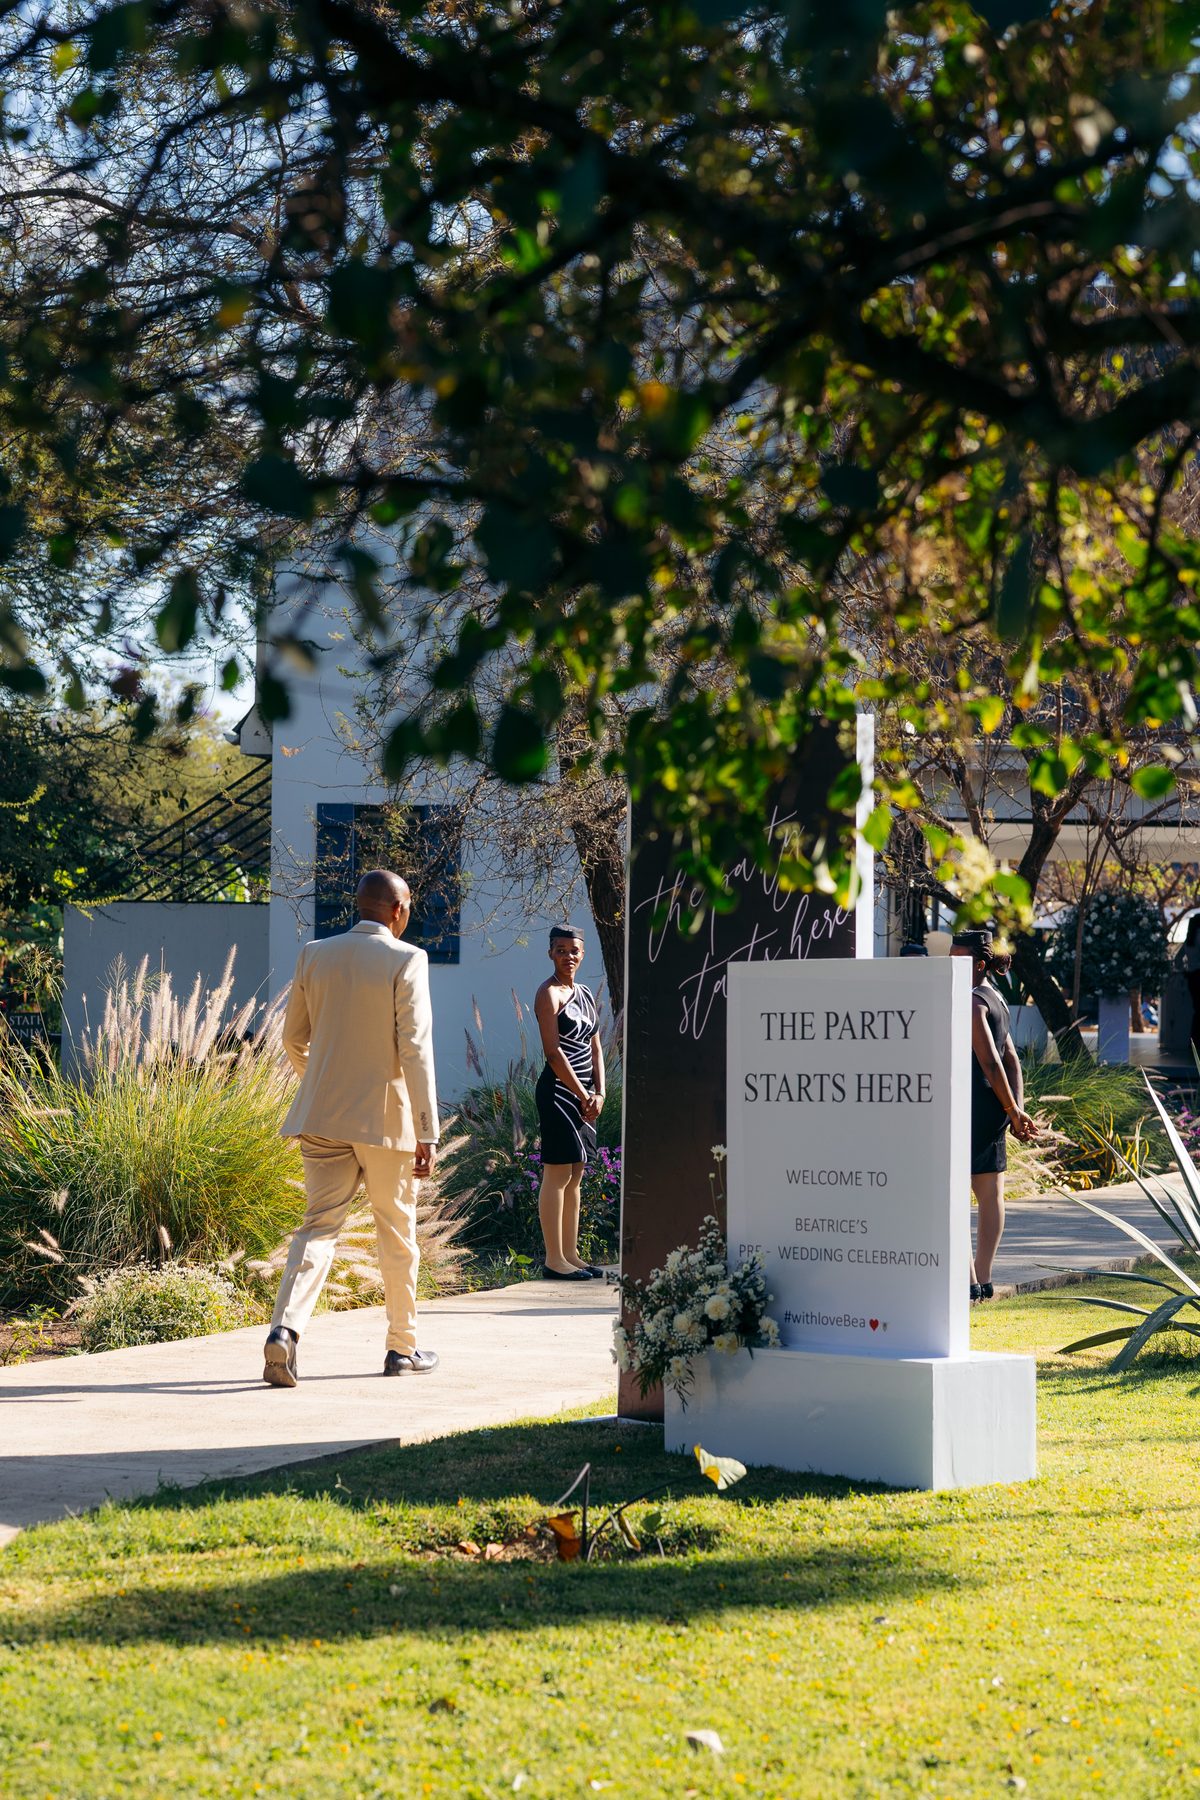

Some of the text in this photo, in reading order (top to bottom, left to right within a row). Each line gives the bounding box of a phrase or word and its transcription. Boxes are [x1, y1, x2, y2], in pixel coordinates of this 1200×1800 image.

[789, 894, 852, 960] here
[760, 1009, 917, 1041] THE PARTY
[744, 1072, 934, 1104] STARTS HERE
[786, 1169, 888, 1187] WELCOME TO
[795, 1217, 868, 1234] BEATRICE’S
[778, 1245, 843, 1263] WEDDING
[847, 1248, 940, 1267] CELEBRATION
[784, 1311, 866, 1329] #withloveBea
